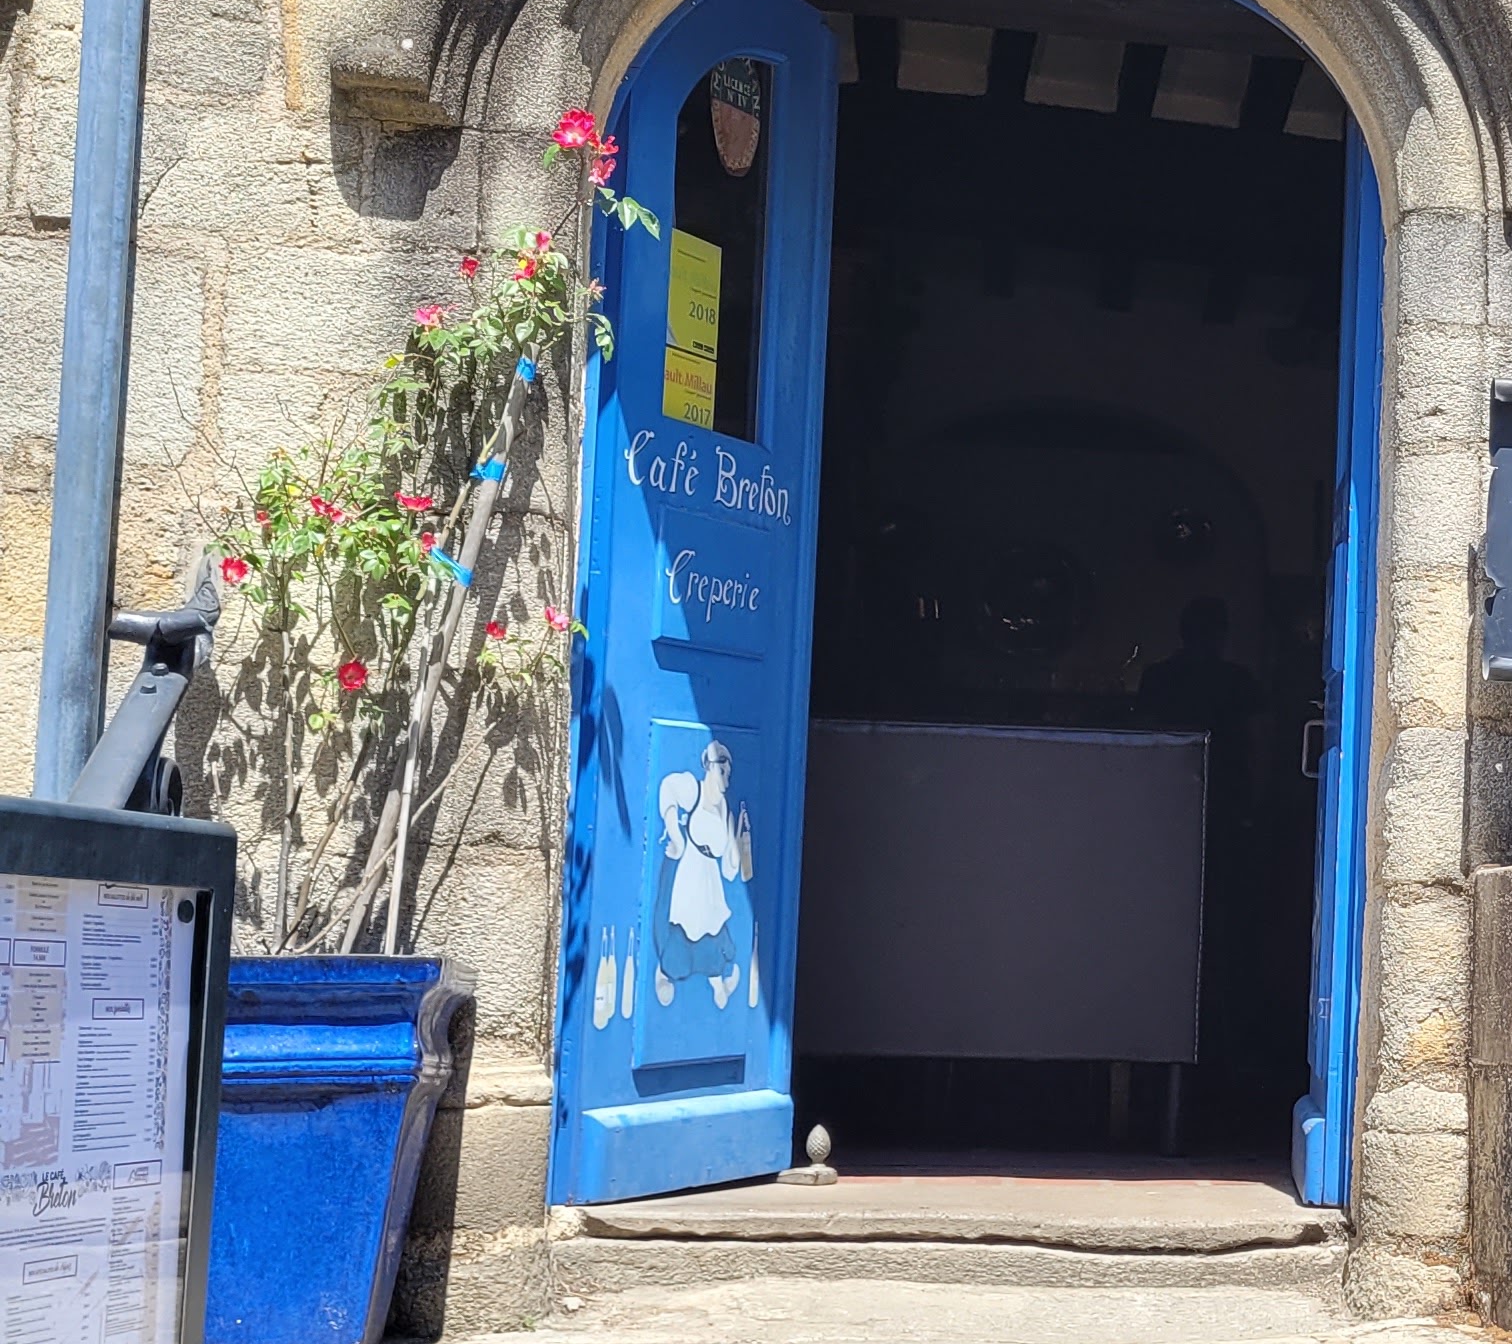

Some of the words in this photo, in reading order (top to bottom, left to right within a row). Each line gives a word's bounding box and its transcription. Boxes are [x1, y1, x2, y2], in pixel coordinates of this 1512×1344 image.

[688, 300, 717, 326] 2018
[683, 401, 711, 426] 2017
[624, 429, 700, 497] Café
[713, 445, 791, 526] Breton
[665, 549, 760, 623] Creperie
[42, 1171, 51, 1183] LE
[32, 1176, 77, 1217] Breton
